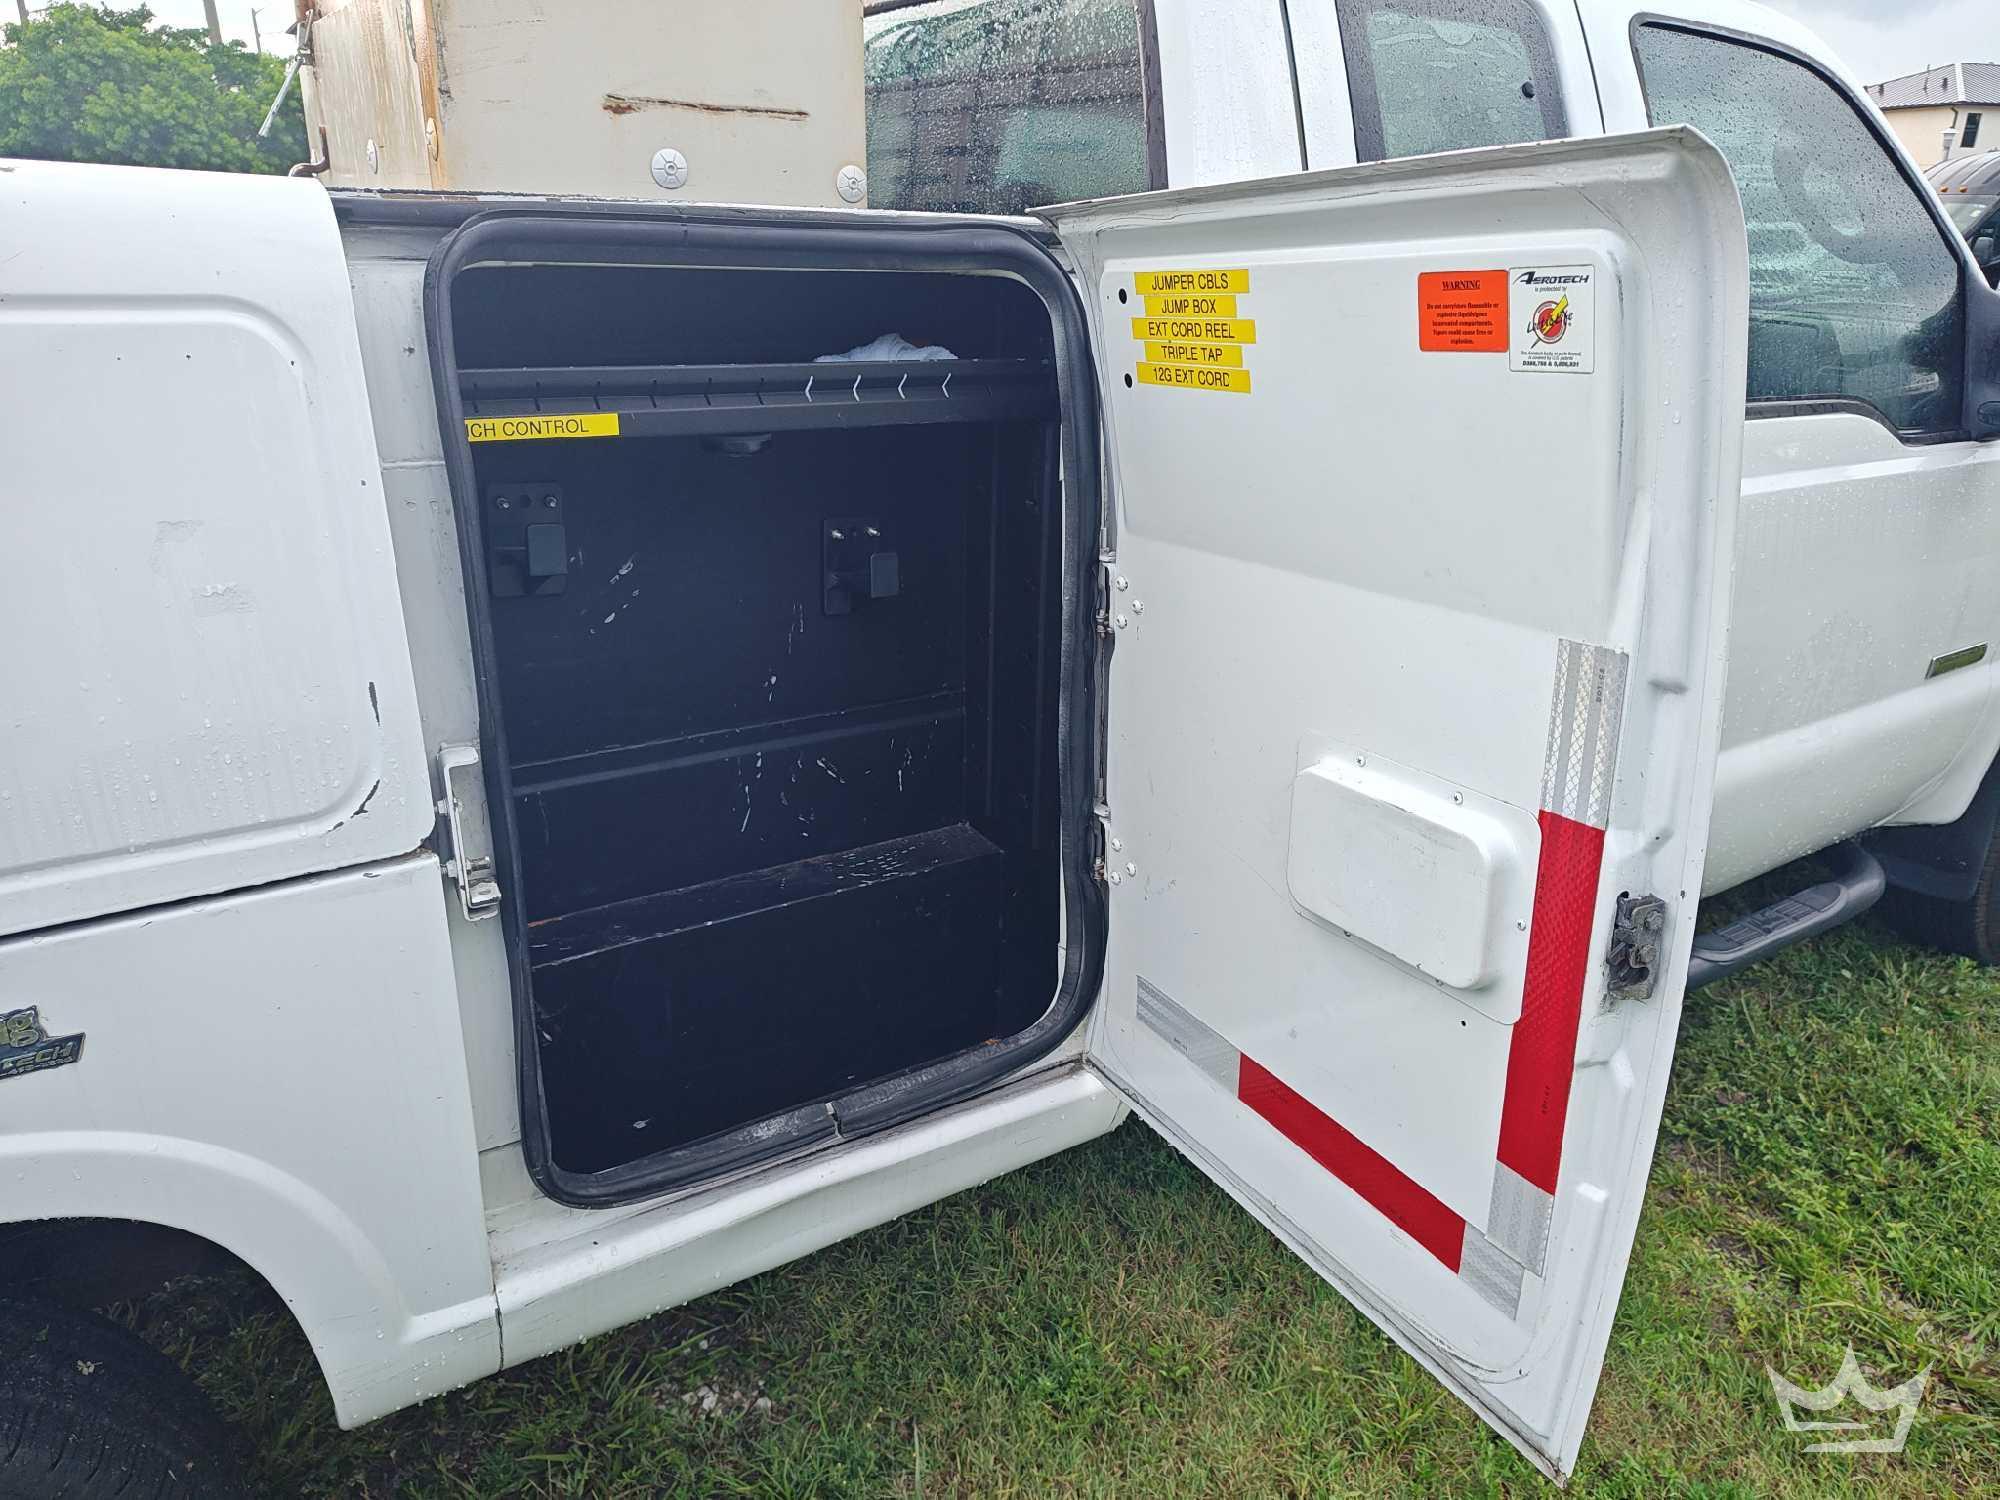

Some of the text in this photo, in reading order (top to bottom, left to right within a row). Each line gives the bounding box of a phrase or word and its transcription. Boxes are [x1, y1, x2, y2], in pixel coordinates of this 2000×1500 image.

[1152, 273, 1229, 290] JUMPER CBLS
[1442, 280, 1480, 291] WARNING
[1513, 271, 1589, 285] AEROTECH
[1162, 299, 1217, 314] JUMP BOX
[1148, 322, 1235, 339] EXT CORD REEL
[1161, 345, 1223, 362] TRIPLE TAP
[1154, 368, 1229, 387] 12G EXT CORD
[502, 419, 589, 437] CONTROL
